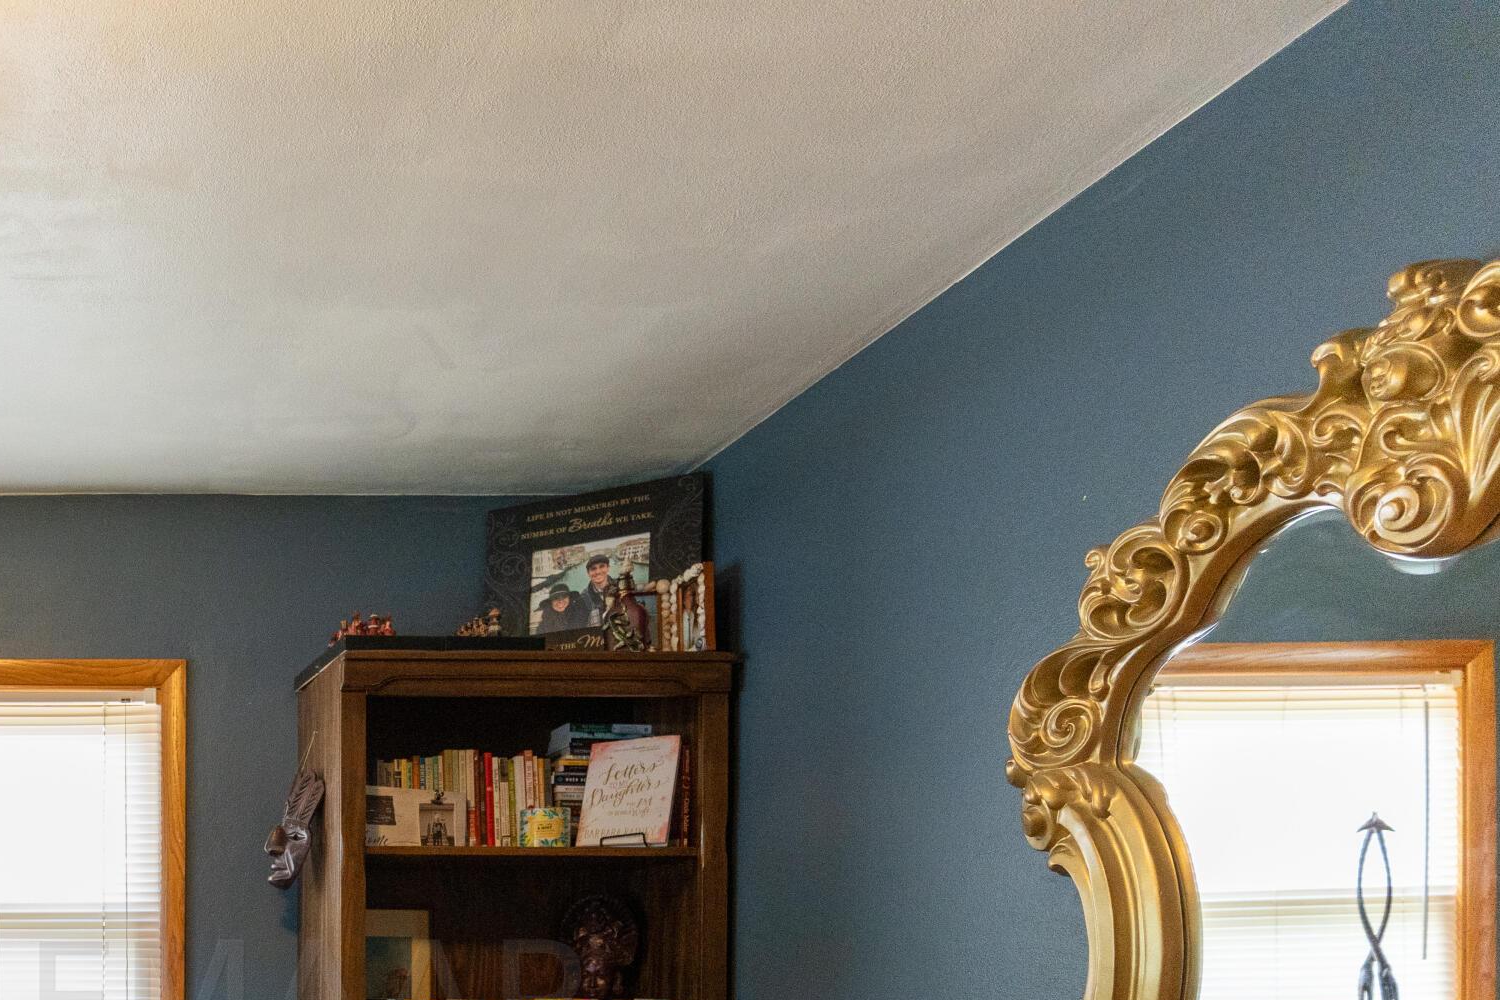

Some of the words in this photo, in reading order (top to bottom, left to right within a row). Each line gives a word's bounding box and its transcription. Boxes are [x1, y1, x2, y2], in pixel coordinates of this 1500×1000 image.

[527, 513, 543, 522] LIFE
[555, 508, 572, 518] NOT
[573, 499, 619, 515] MEASURED
[521, 528, 554, 540] NUMBER
[556, 526, 567, 534] OF
[568, 511, 613, 533] Breaths
[603, 761, 660, 785] Letters
[590, 777, 662, 808] Daughters
